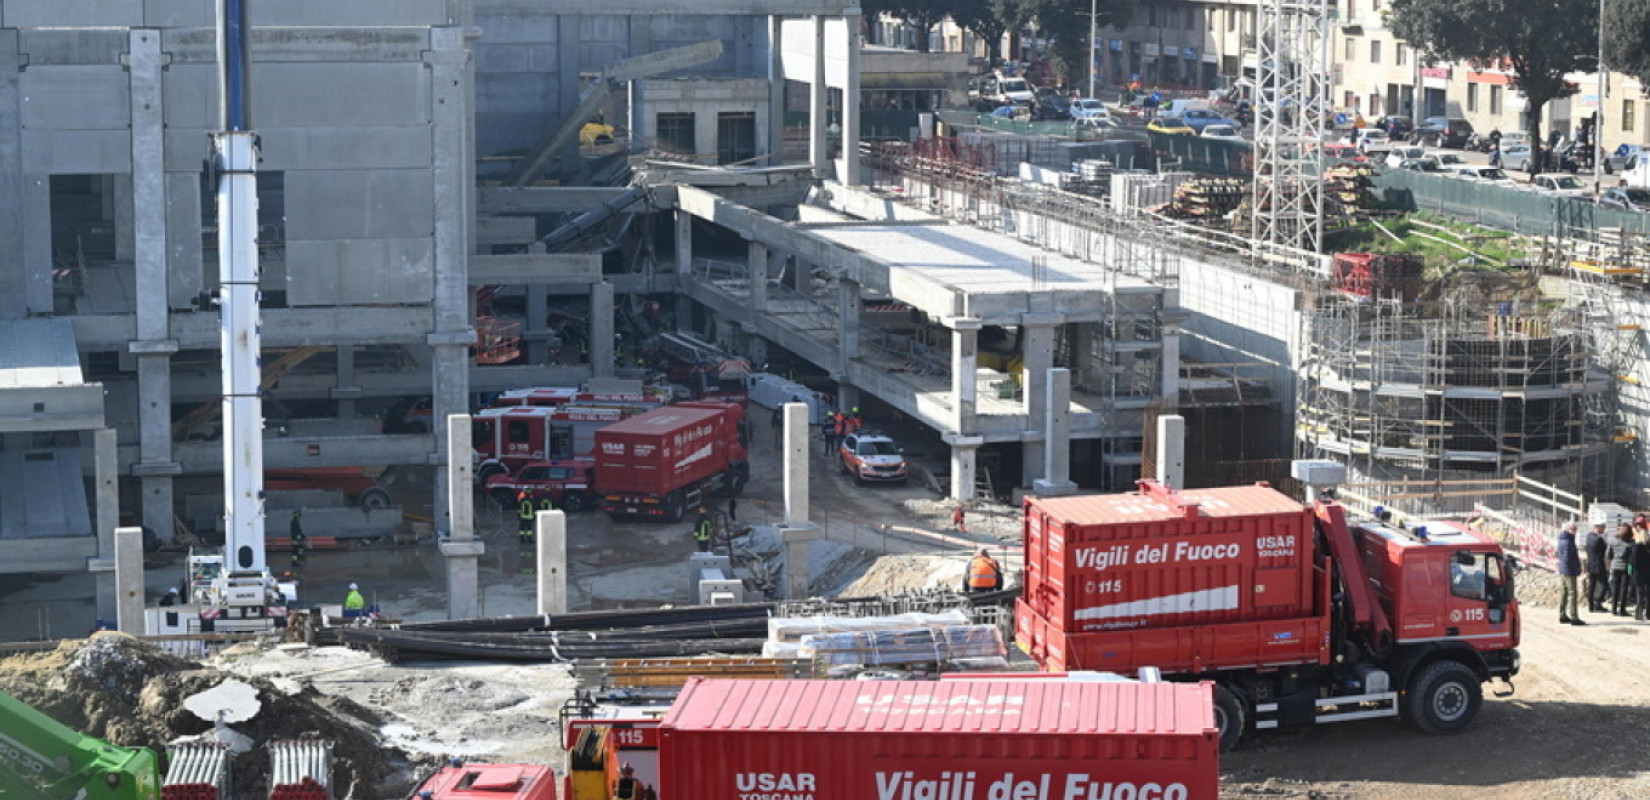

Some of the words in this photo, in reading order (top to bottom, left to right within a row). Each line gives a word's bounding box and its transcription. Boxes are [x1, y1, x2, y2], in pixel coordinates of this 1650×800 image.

[1257, 535, 1295, 549] USAR
[1074, 544, 1129, 571] Vigili
[1135, 542, 1168, 564] del
[1174, 541, 1240, 562] Fuoco
[1098, 580, 1122, 593] 115
[1465, 608, 1485, 621] 115
[855, 694, 1024, 706] USAR
[619, 729, 644, 744] 115
[735, 773, 816, 792] USAR
[874, 771, 977, 800] Vigili
[987, 773, 1051, 800] del
[1064, 774, 1188, 800] Fuoco
